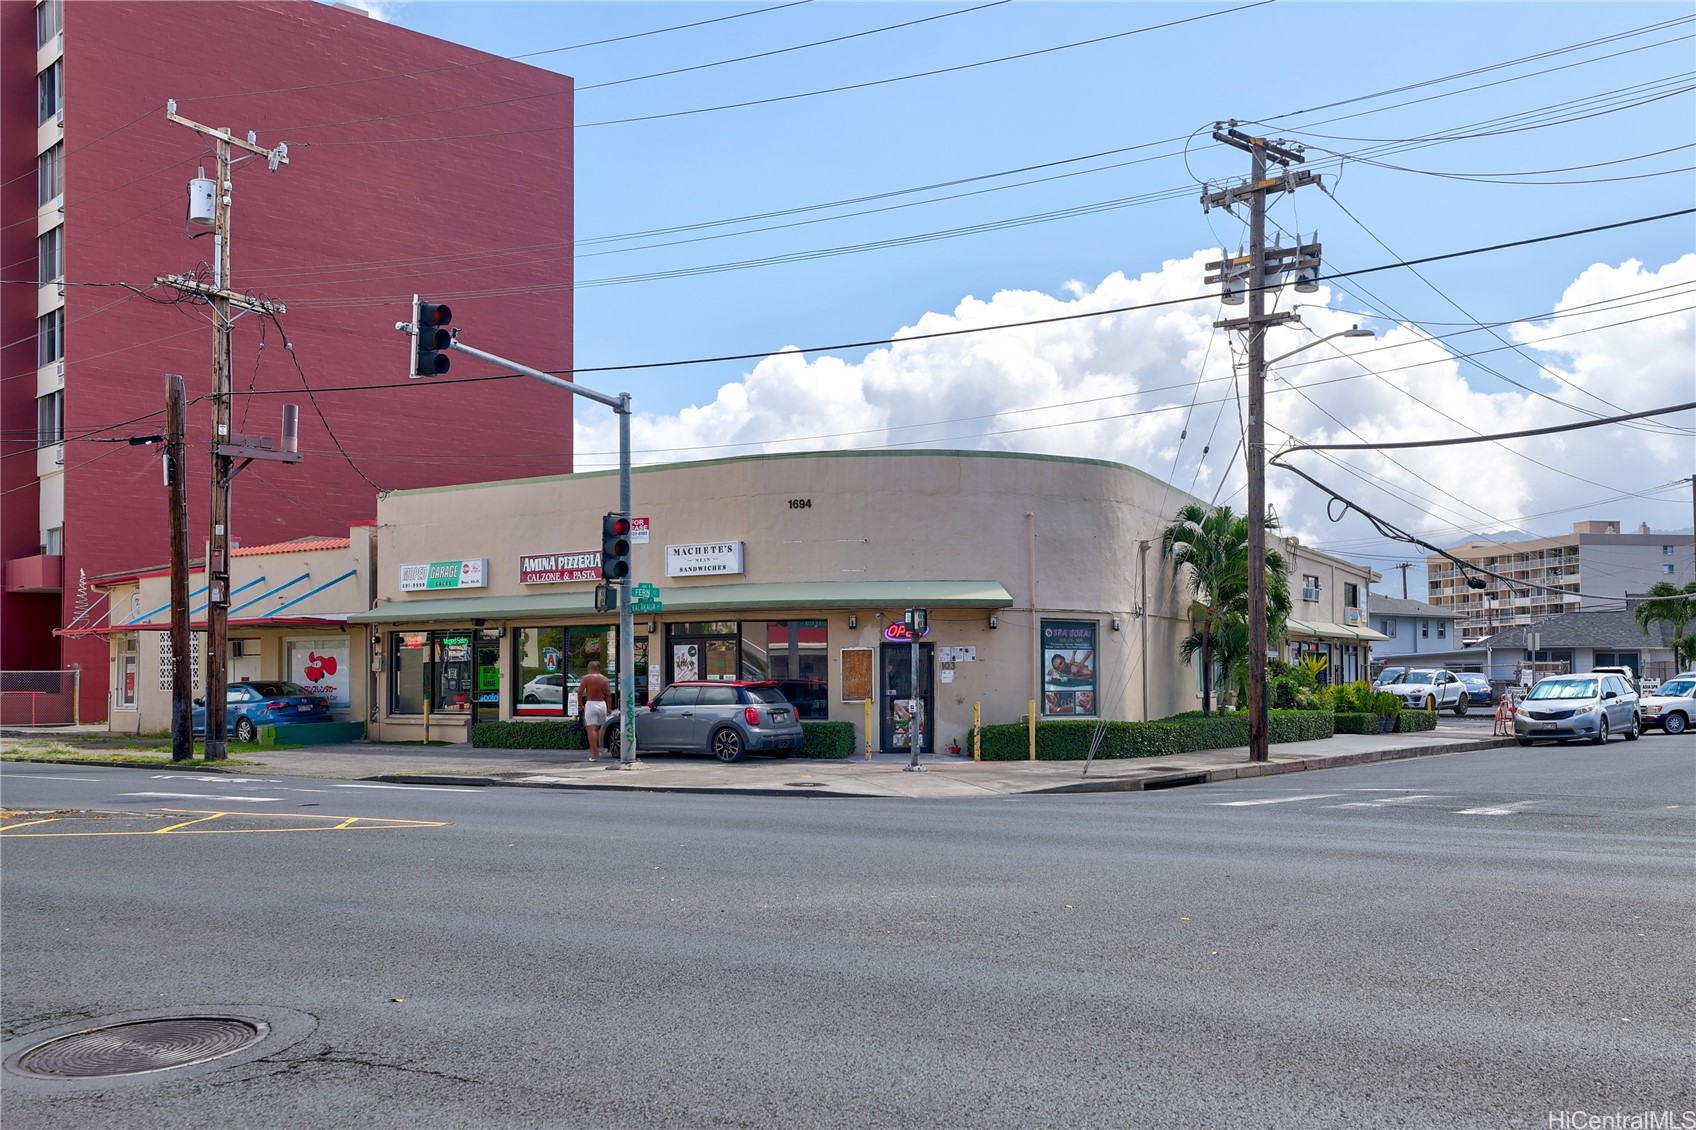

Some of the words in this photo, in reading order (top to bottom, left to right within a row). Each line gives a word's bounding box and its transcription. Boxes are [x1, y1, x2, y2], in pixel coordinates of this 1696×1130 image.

[788, 499, 812, 509] 1694
[673, 545, 733, 556] MACHETE'S
[523, 556, 556, 572] AMINA
[558, 552, 602, 569] PIZZERIA
[403, 566, 428, 581] MOPED
[430, 565, 459, 579] GARAGE
[679, 564, 727, 573] SANDWICHES
[527, 571, 561, 582] CALZONE
[563, 571, 570, 580] &
[573, 570, 596, 579] PASTA
[635, 588, 651, 597] FERN
[1053, 629, 1067, 637] SPA
[941, 662, 955, 670] 103
